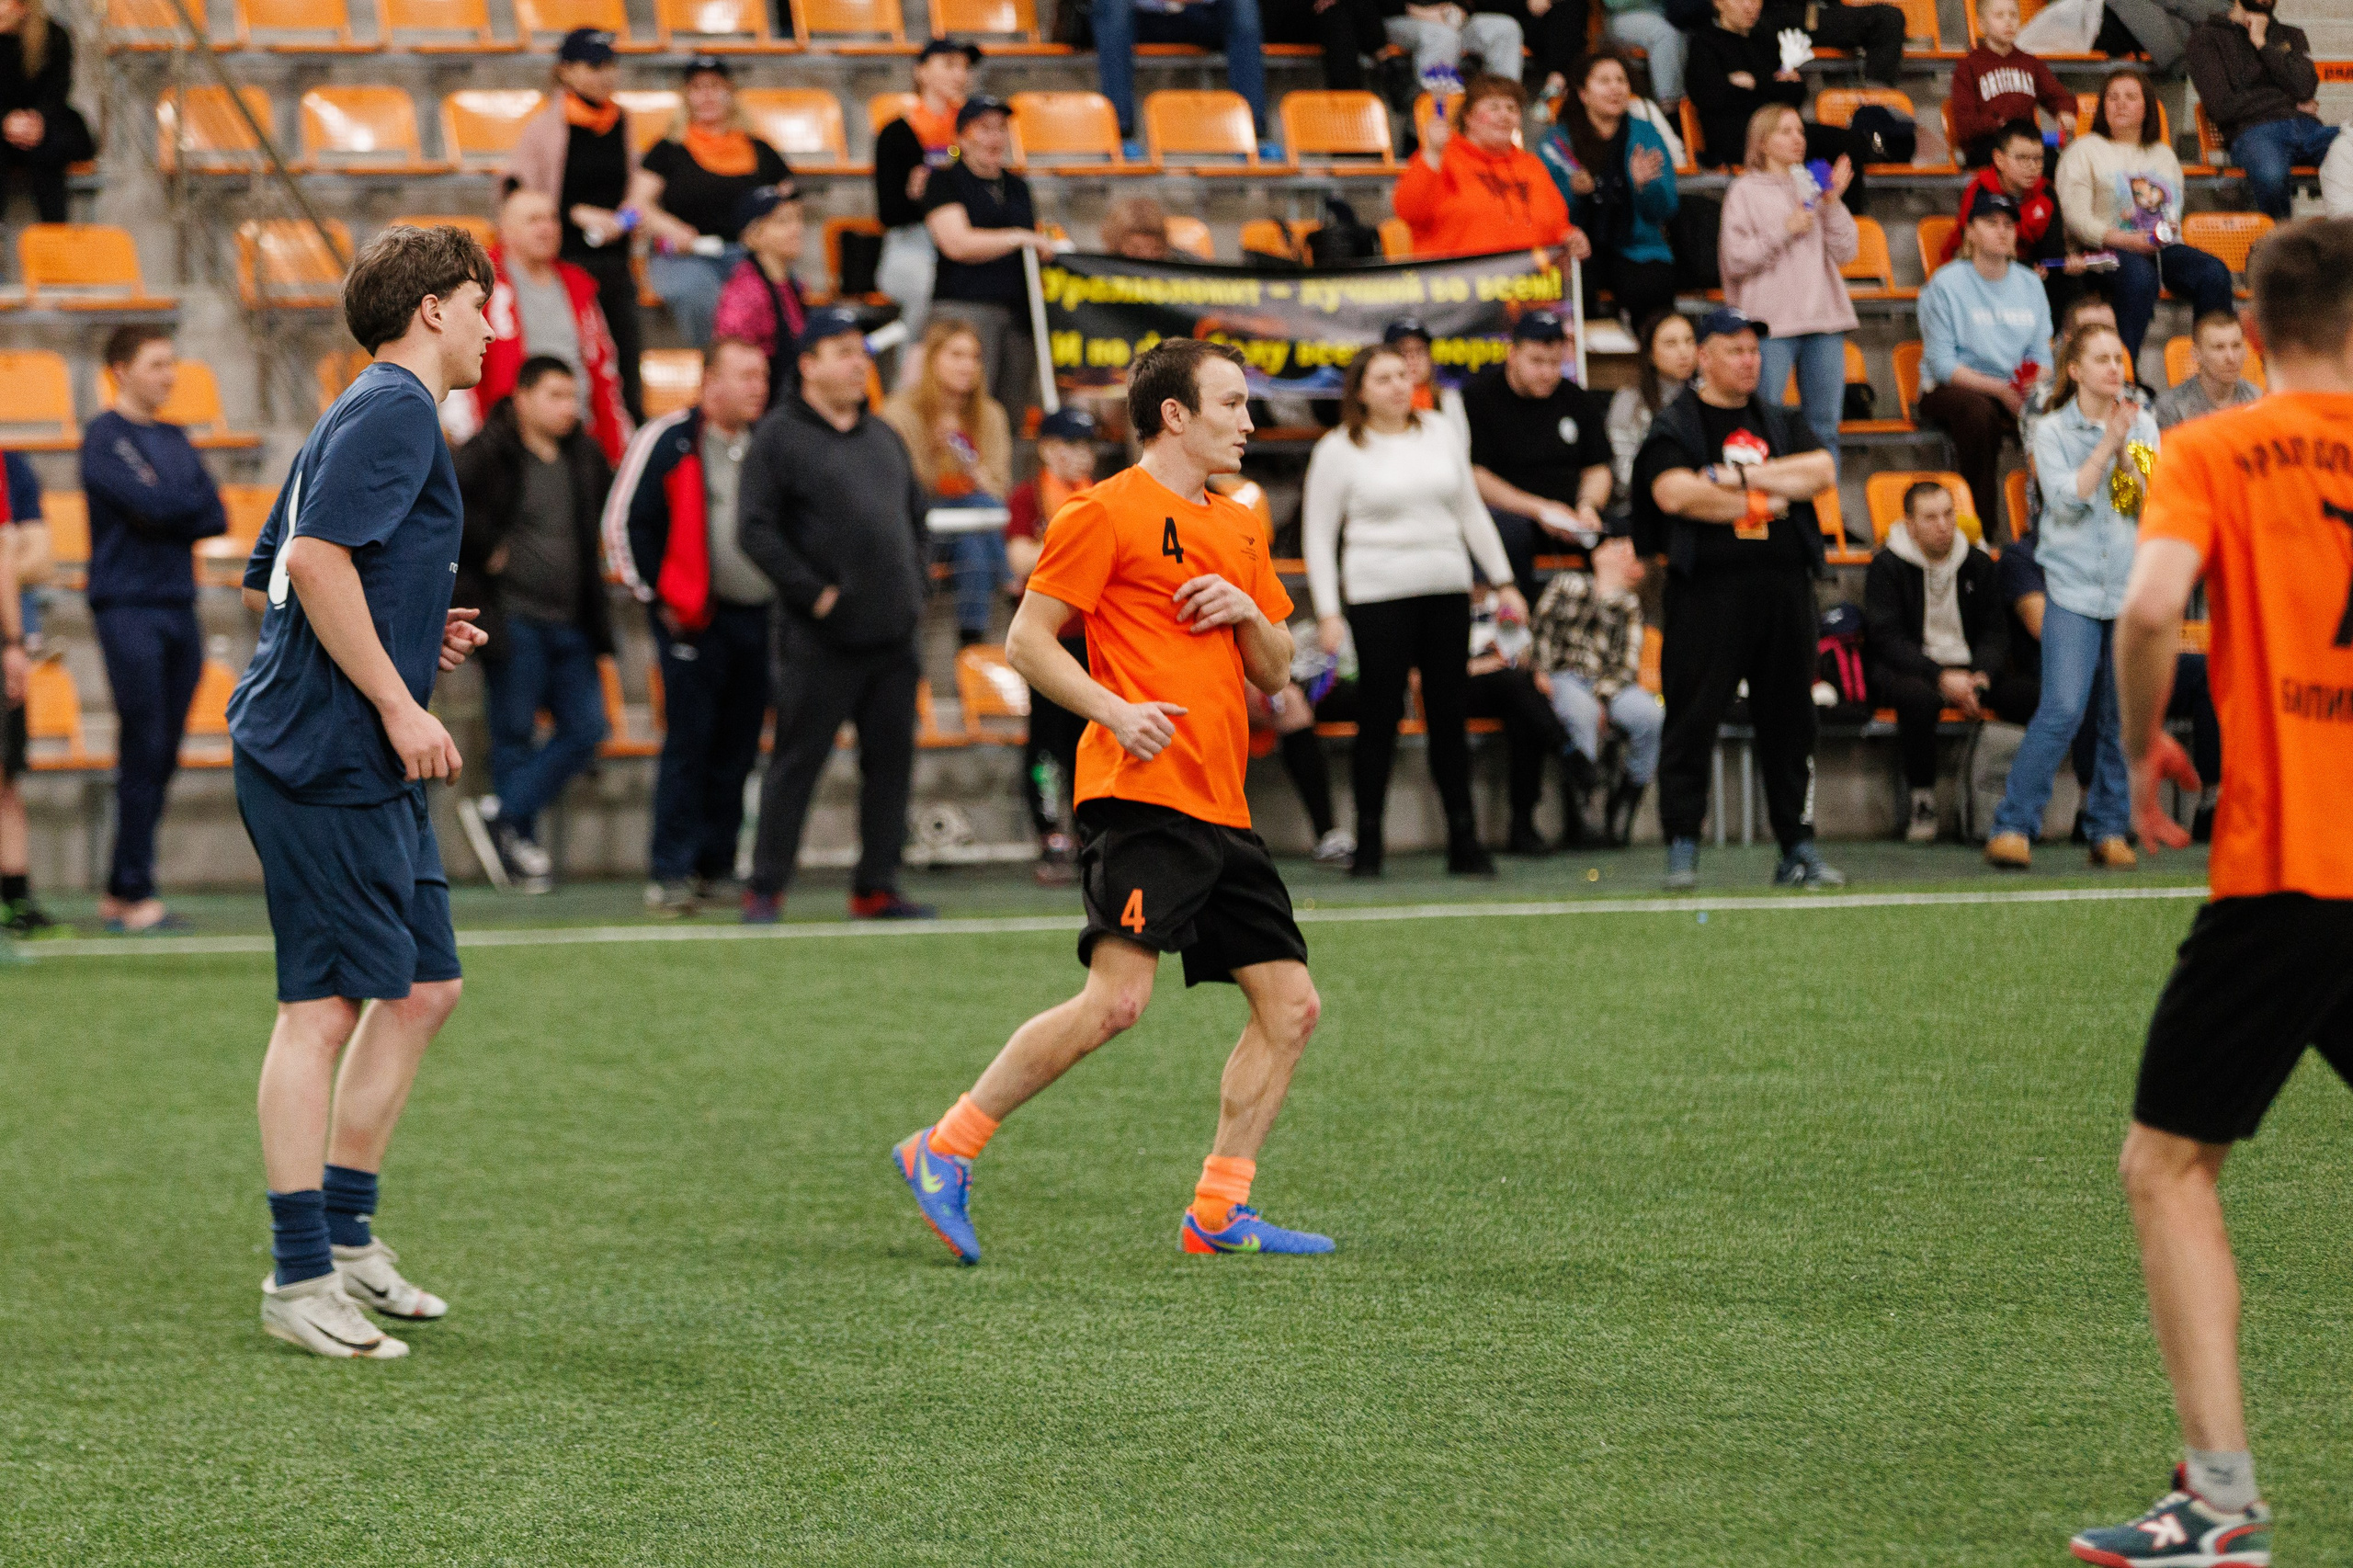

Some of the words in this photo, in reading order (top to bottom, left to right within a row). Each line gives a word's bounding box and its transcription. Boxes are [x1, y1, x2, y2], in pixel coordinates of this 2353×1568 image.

[1429, 278, 1469, 302] во
[1051, 330, 1083, 367] И
[1086, 338, 1131, 368] по
[1163, 517, 1184, 563] 4
[1120, 888, 1146, 934] 4
